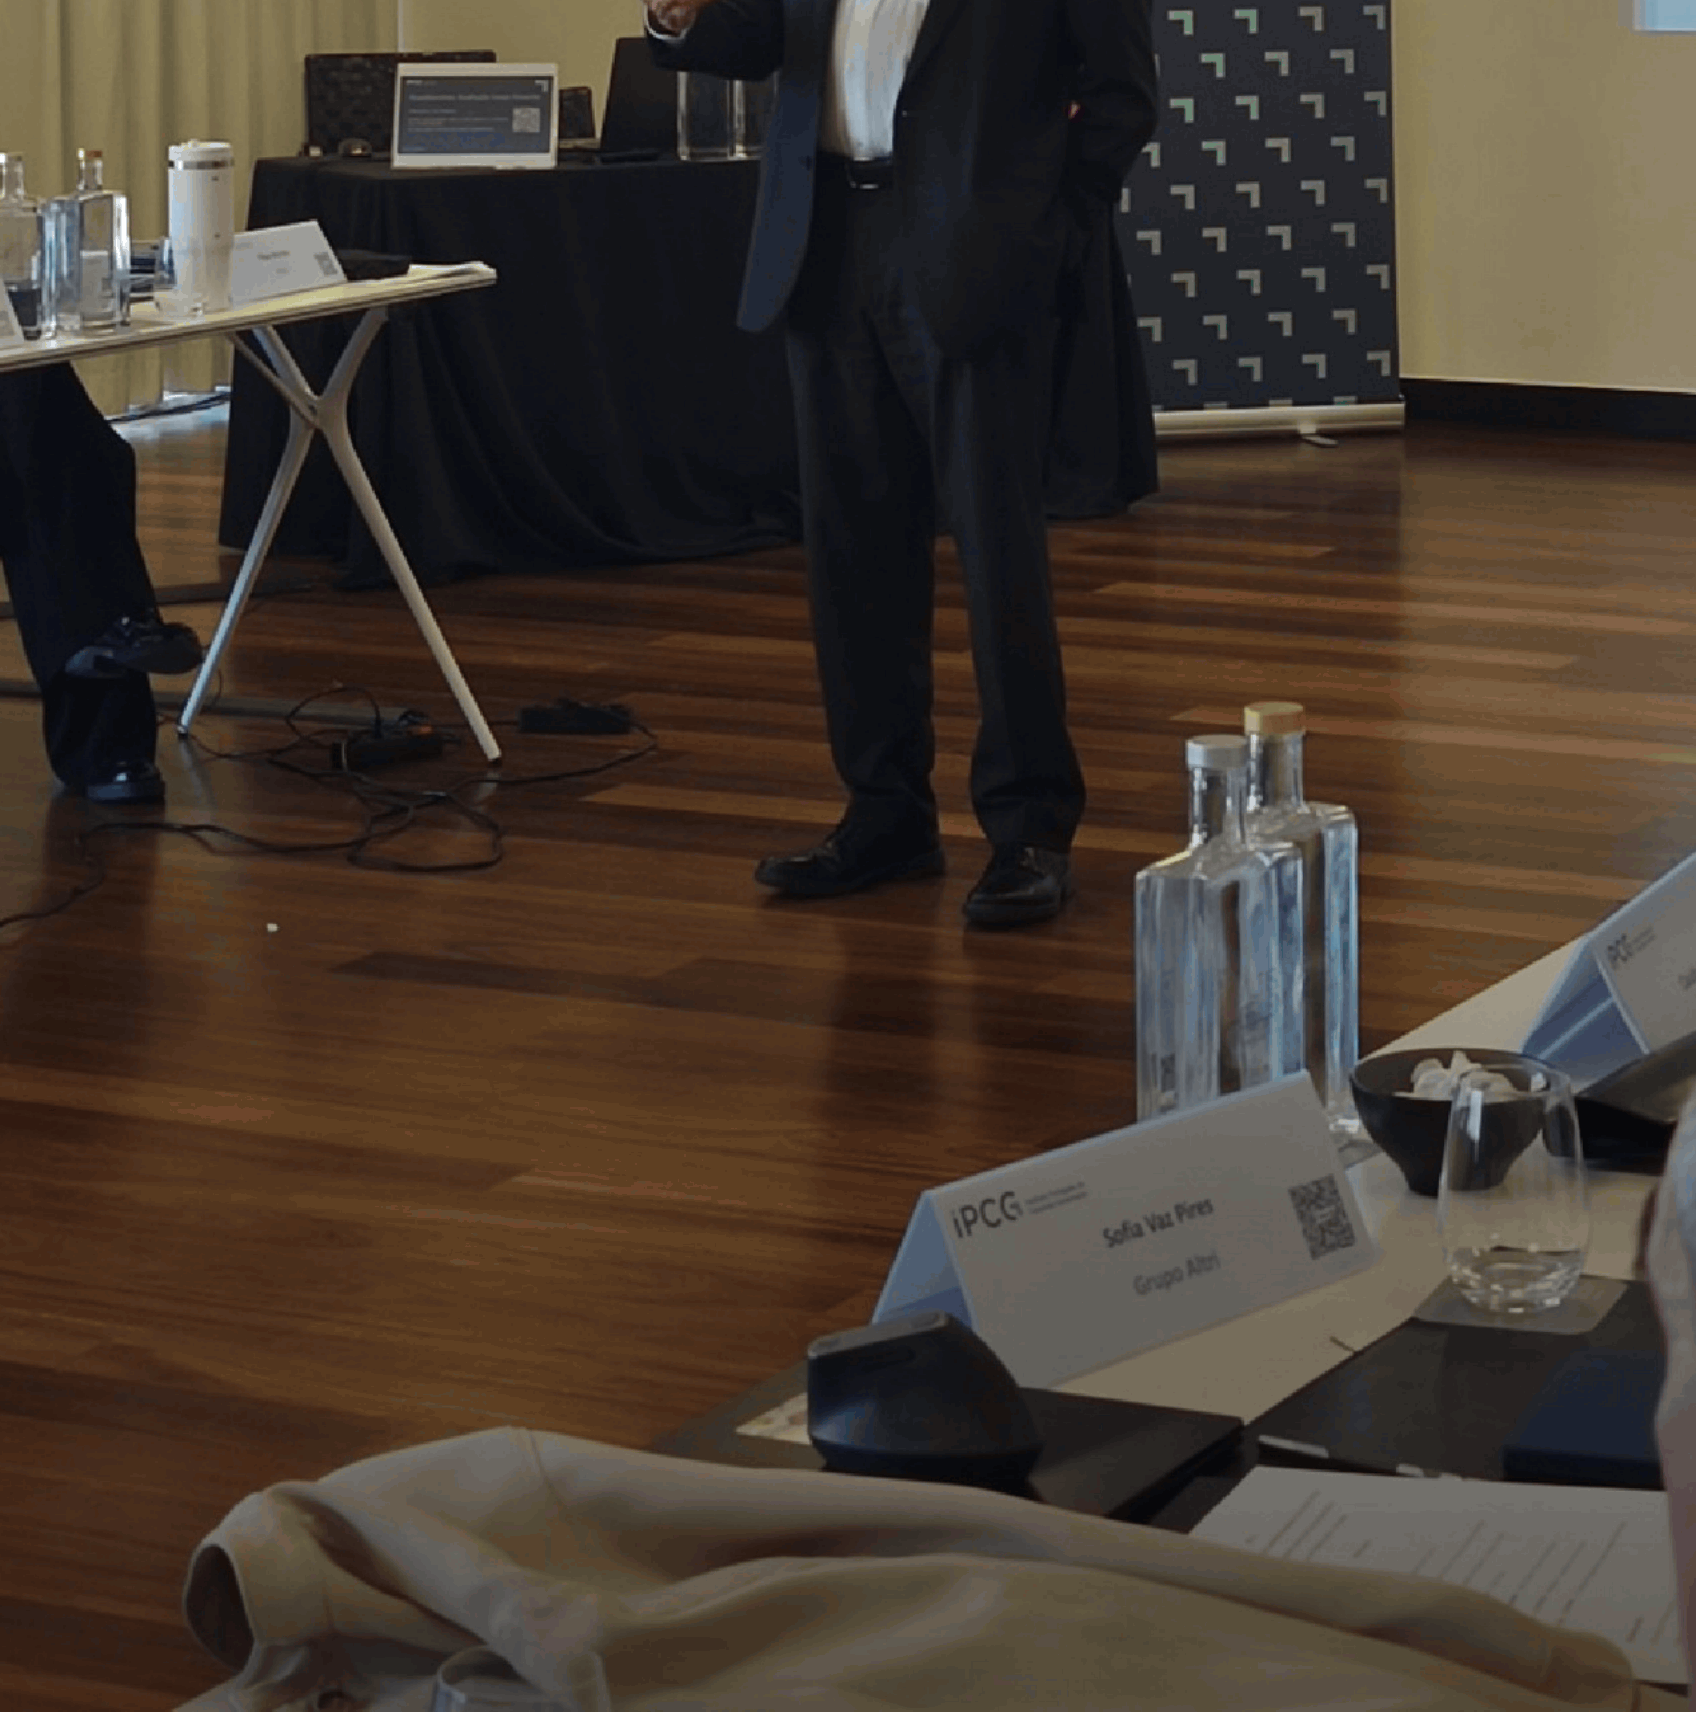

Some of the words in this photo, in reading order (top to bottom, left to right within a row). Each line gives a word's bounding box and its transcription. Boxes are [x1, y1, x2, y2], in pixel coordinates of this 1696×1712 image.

[1102, 1217, 1145, 1248] Sofia
[1142, 1210, 1176, 1234] Vaz
[1174, 1197, 1214, 1225] Pires
[1132, 1265, 1184, 1296] Grupo
